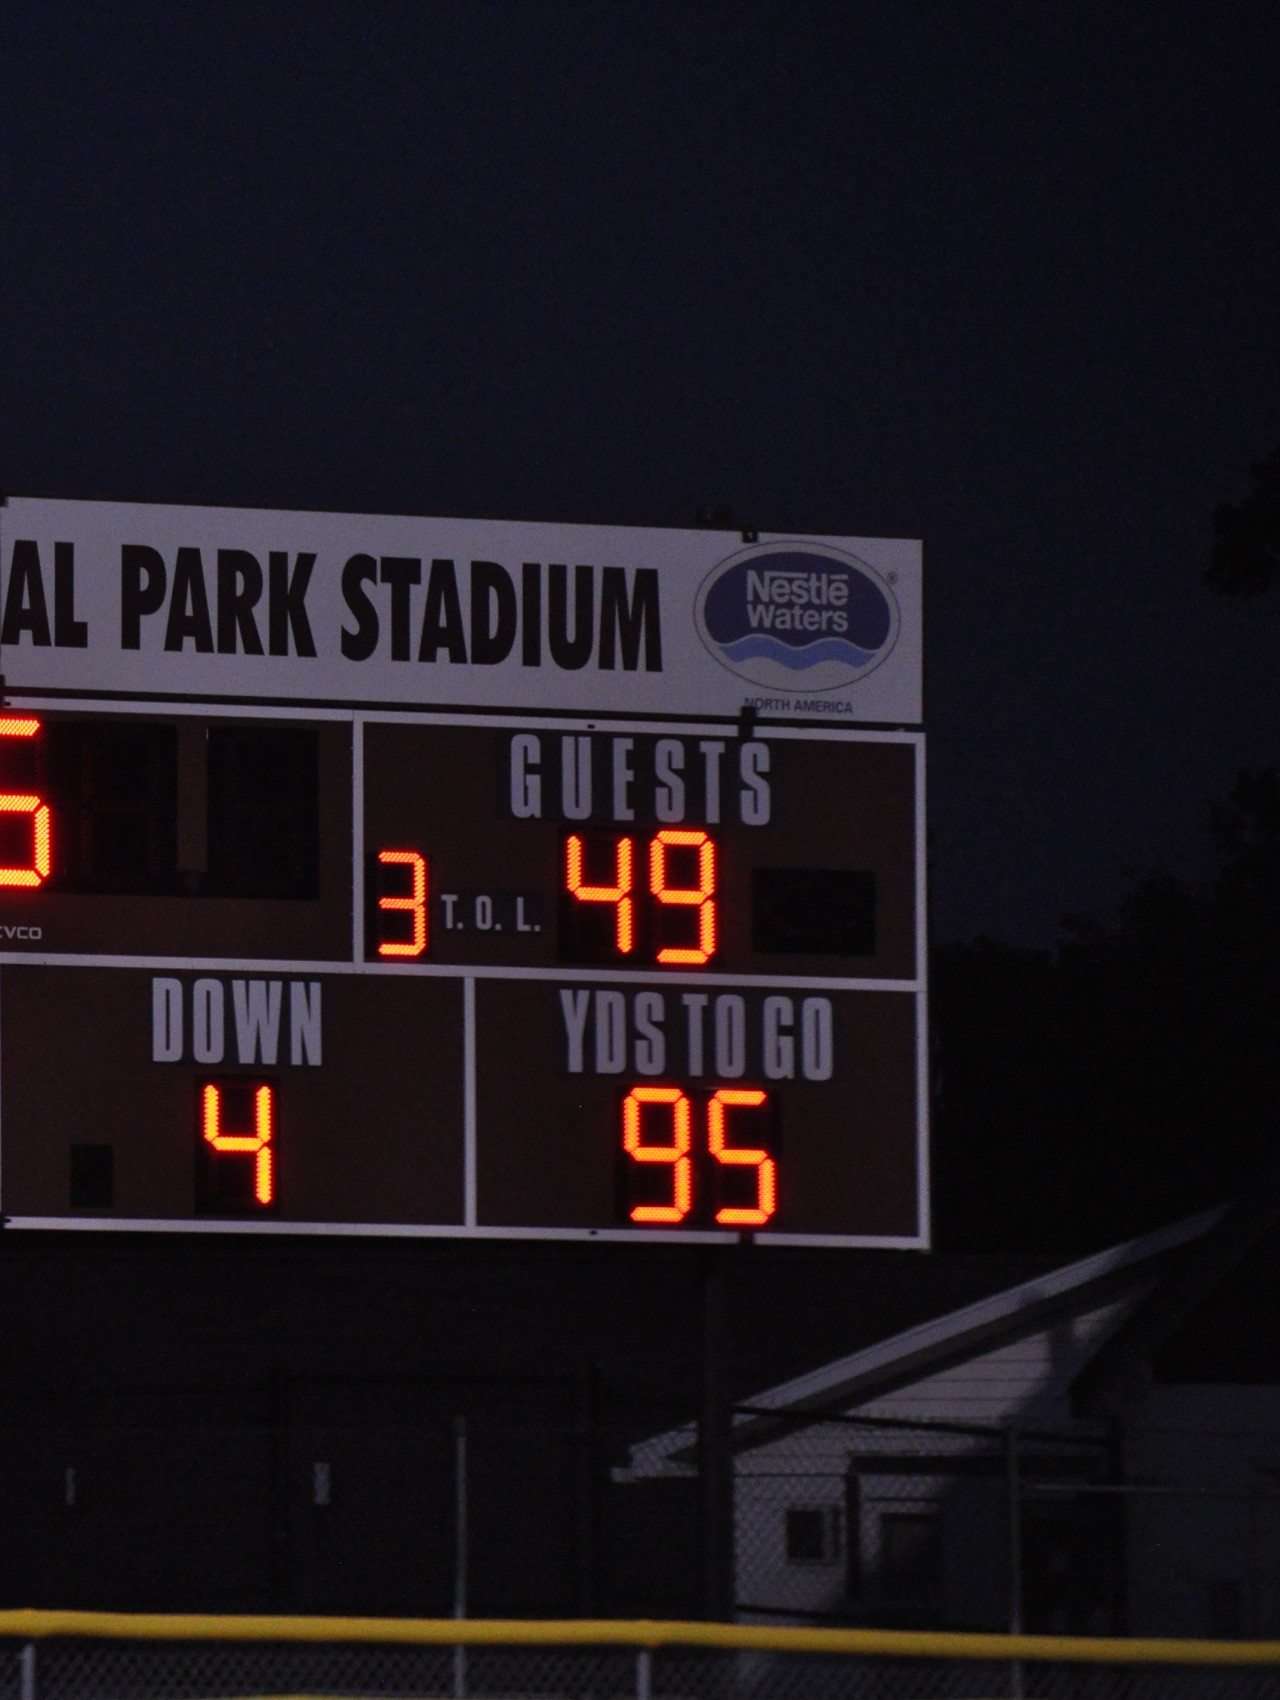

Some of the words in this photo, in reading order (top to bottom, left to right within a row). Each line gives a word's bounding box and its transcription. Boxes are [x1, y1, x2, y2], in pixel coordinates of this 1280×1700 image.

[120, 543, 318, 658] PARK
[340, 552, 663, 673] STADIUM
[745, 602, 850, 633] Waters
[744, 697, 790, 712] NORTH
[794, 700, 854, 714] AMERICA
[509, 732, 772, 827] GUESTS
[376, 849, 428, 957] 3
[565, 829, 717, 966] 49
[151, 976, 323, 1067] DOWN
[558, 988, 666, 1076] YDS
[680, 992, 746, 1078] TO
[762, 996, 834, 1082] GO
[202, 1082, 275, 1207] 4
[621, 1085, 778, 1226] 95
